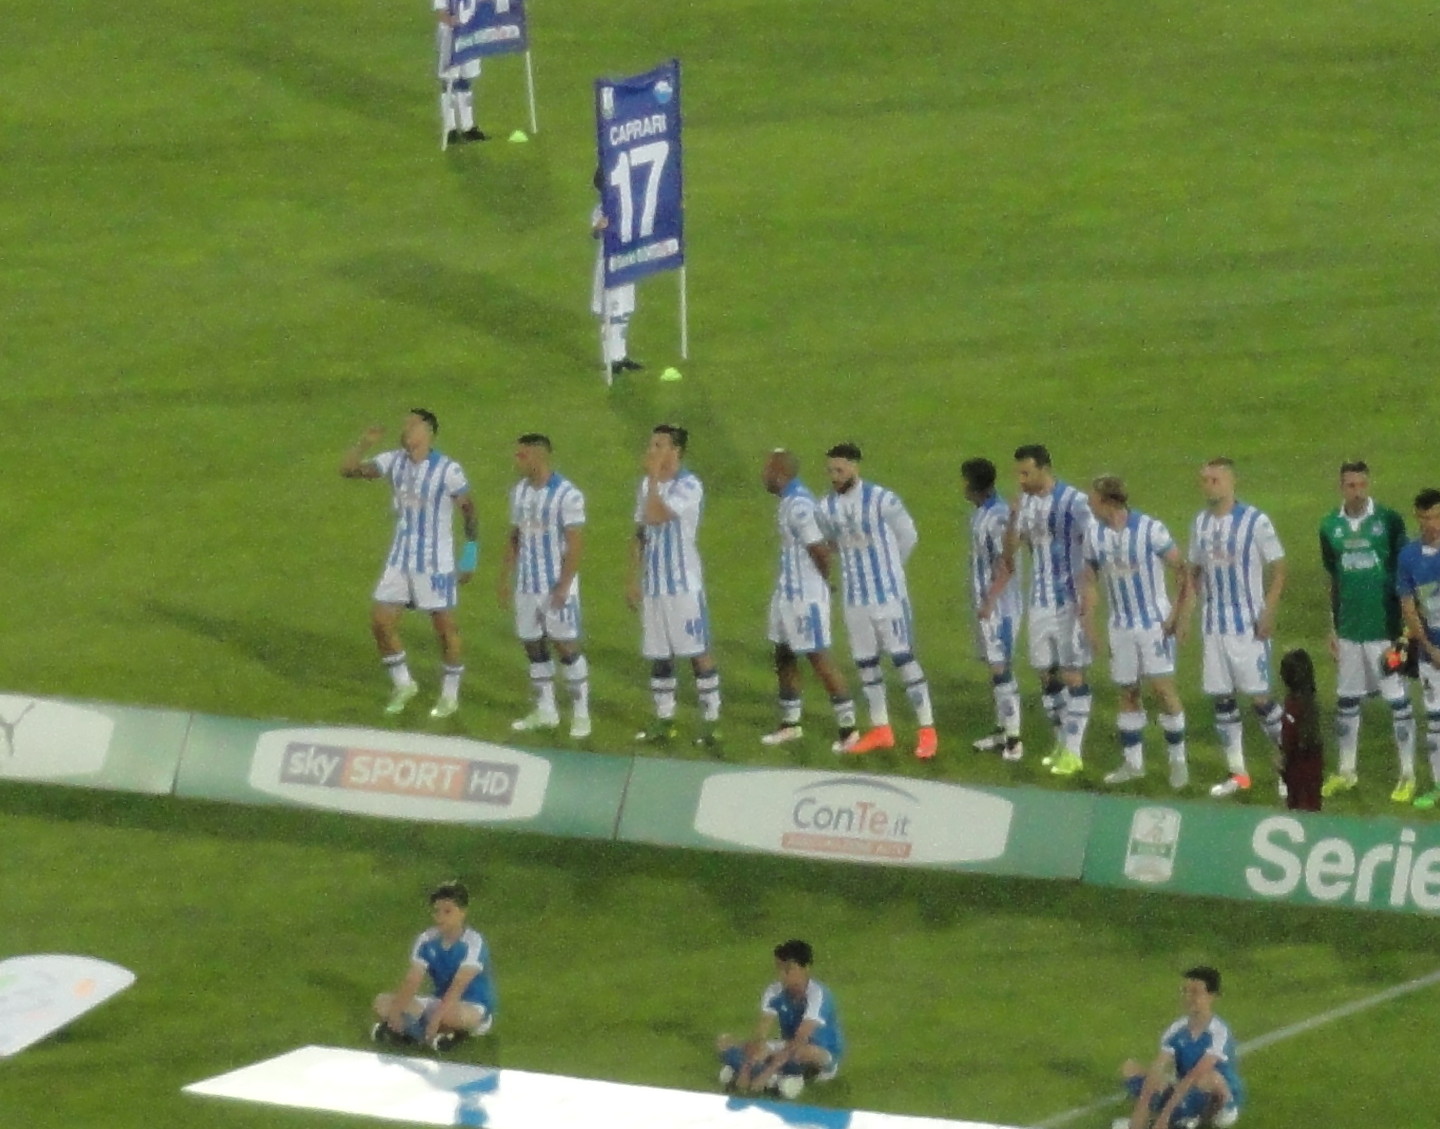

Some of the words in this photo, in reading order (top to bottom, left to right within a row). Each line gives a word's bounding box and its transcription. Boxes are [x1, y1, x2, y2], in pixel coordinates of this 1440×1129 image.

[609, 113, 668, 146] CAPRARI
[610, 141, 670, 243] 17
[287, 745, 343, 787] sky
[348, 753, 463, 794] SPORT
[470, 765, 510, 798] HD
[792, 797, 912, 838] ConTe.it
